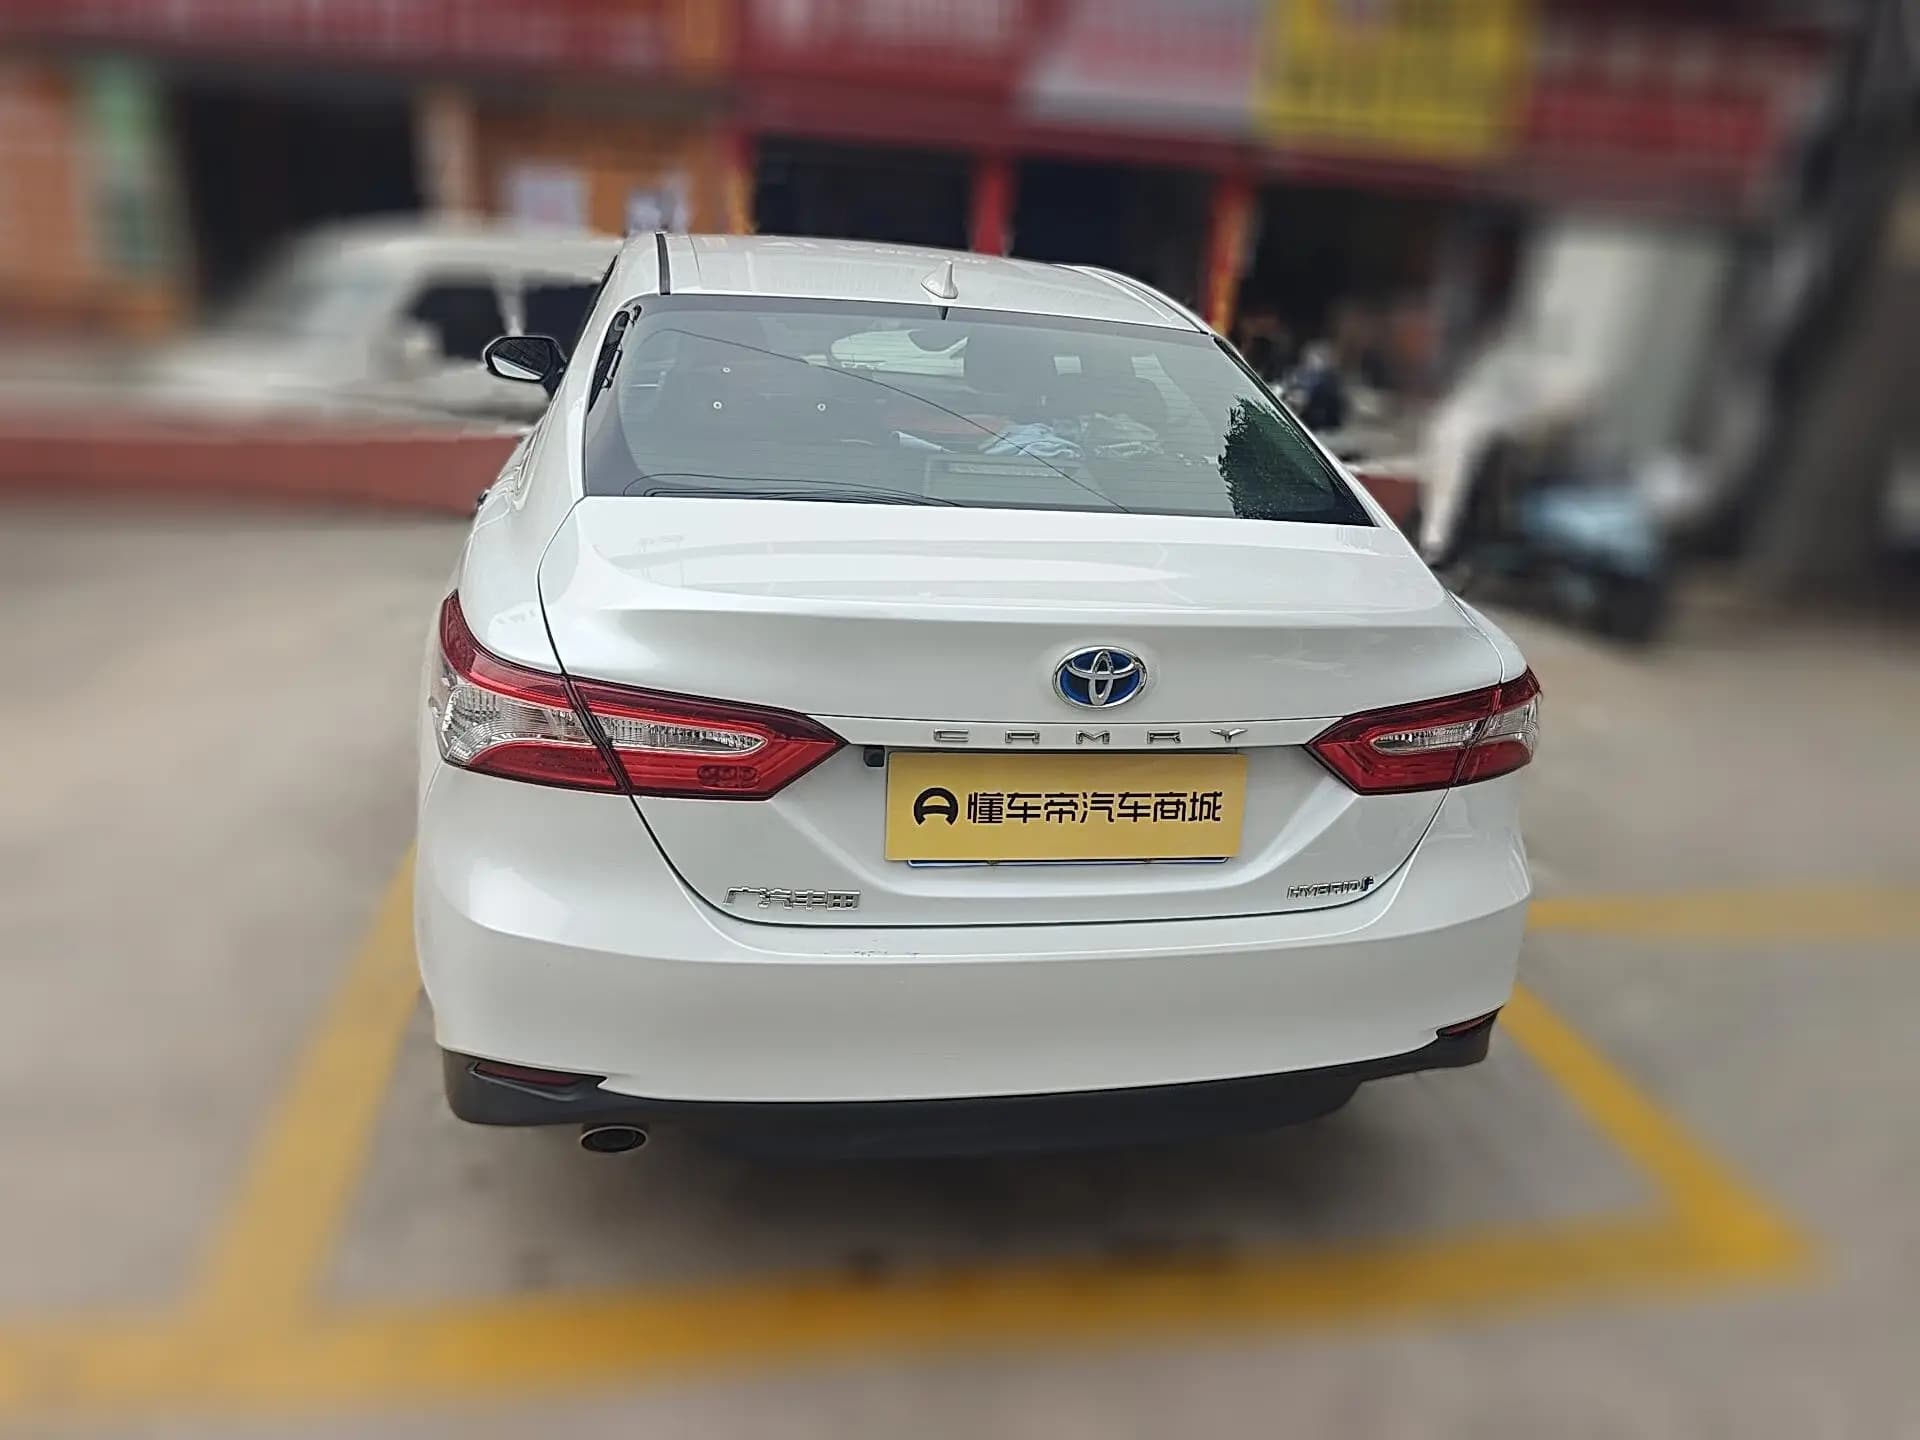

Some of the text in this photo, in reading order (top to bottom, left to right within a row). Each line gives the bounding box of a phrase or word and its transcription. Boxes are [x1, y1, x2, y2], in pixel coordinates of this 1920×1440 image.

[932, 728, 1249, 745] CAMRY
[723, 887, 861, 910] 广汽丰田
